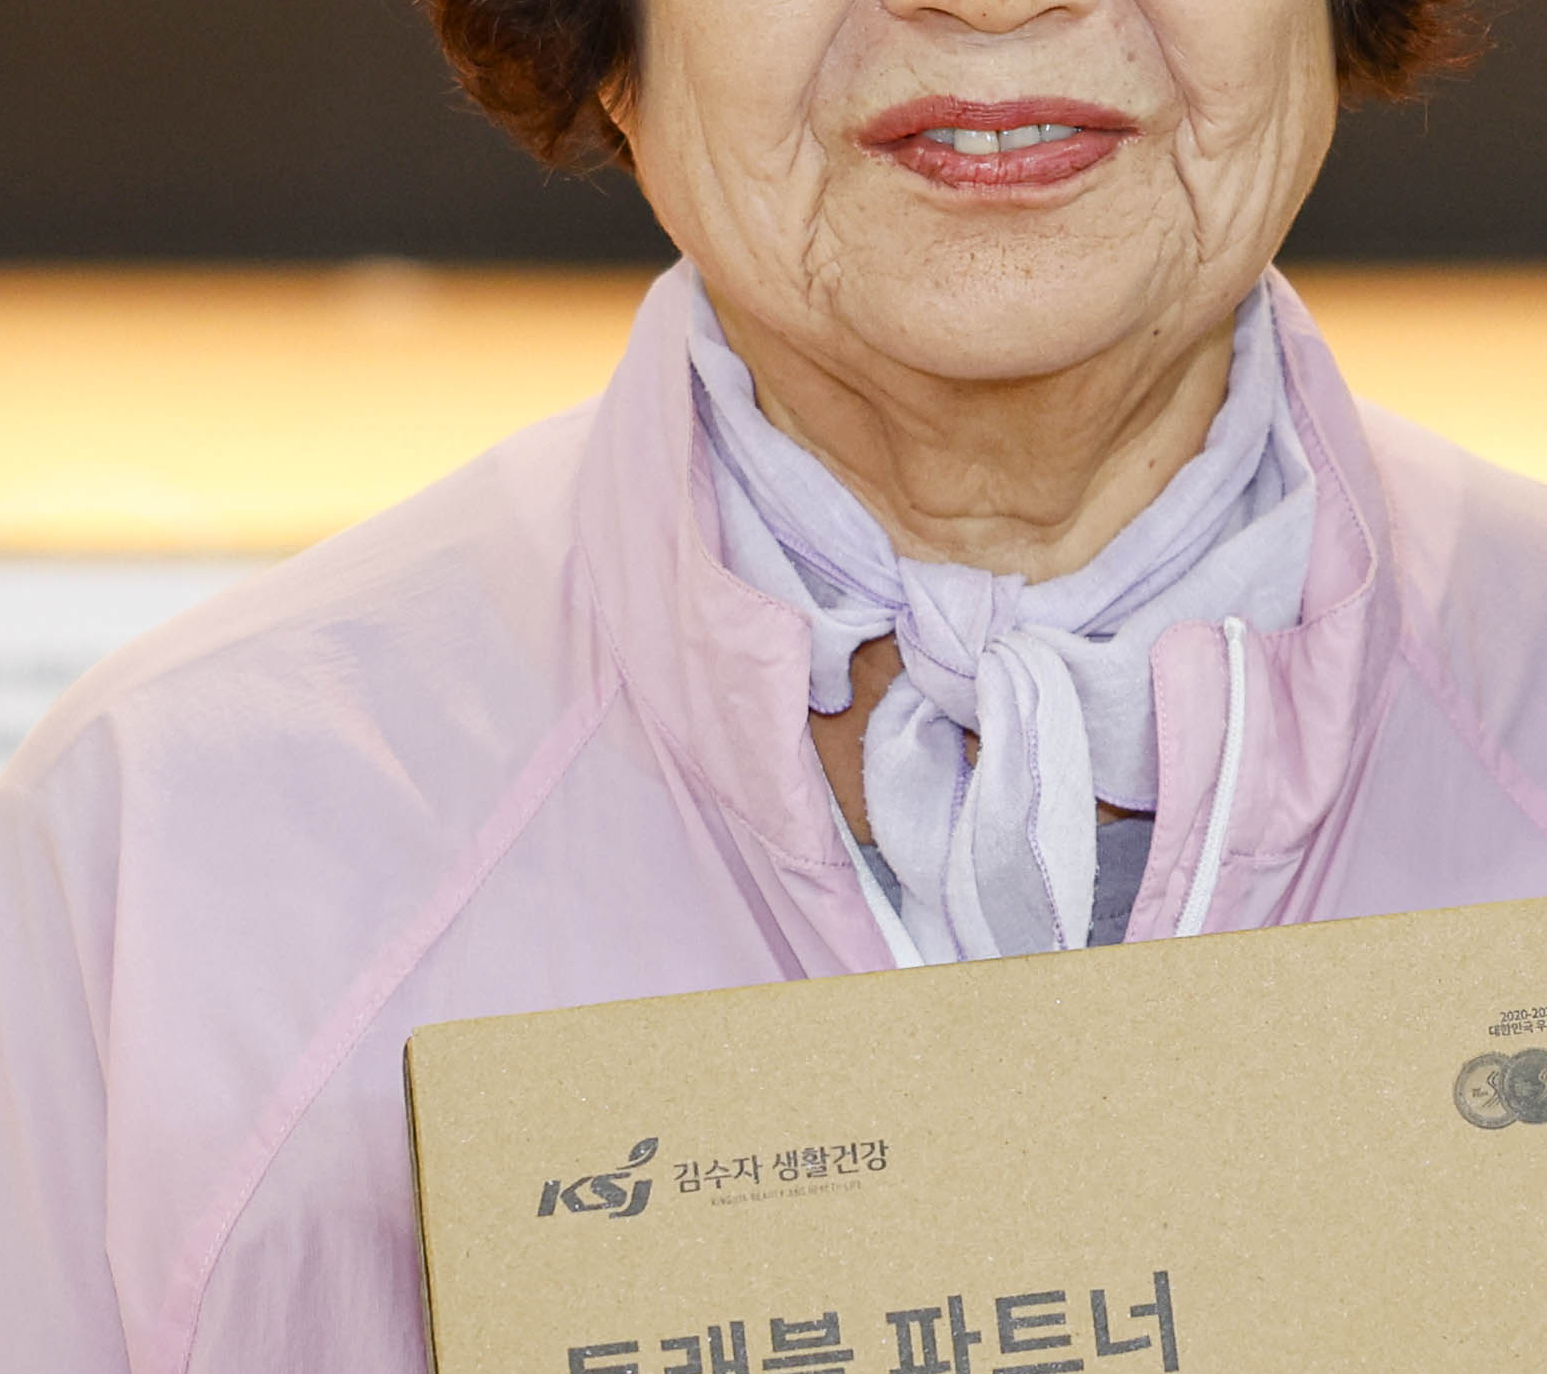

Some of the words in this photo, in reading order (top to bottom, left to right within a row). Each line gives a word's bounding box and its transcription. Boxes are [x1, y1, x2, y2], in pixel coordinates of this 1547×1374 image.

[1488, 1020, 1534, 1036] 대한민국
[672, 1154, 763, 1194] 김수자
[772, 1139, 890, 1182] 생활건강
